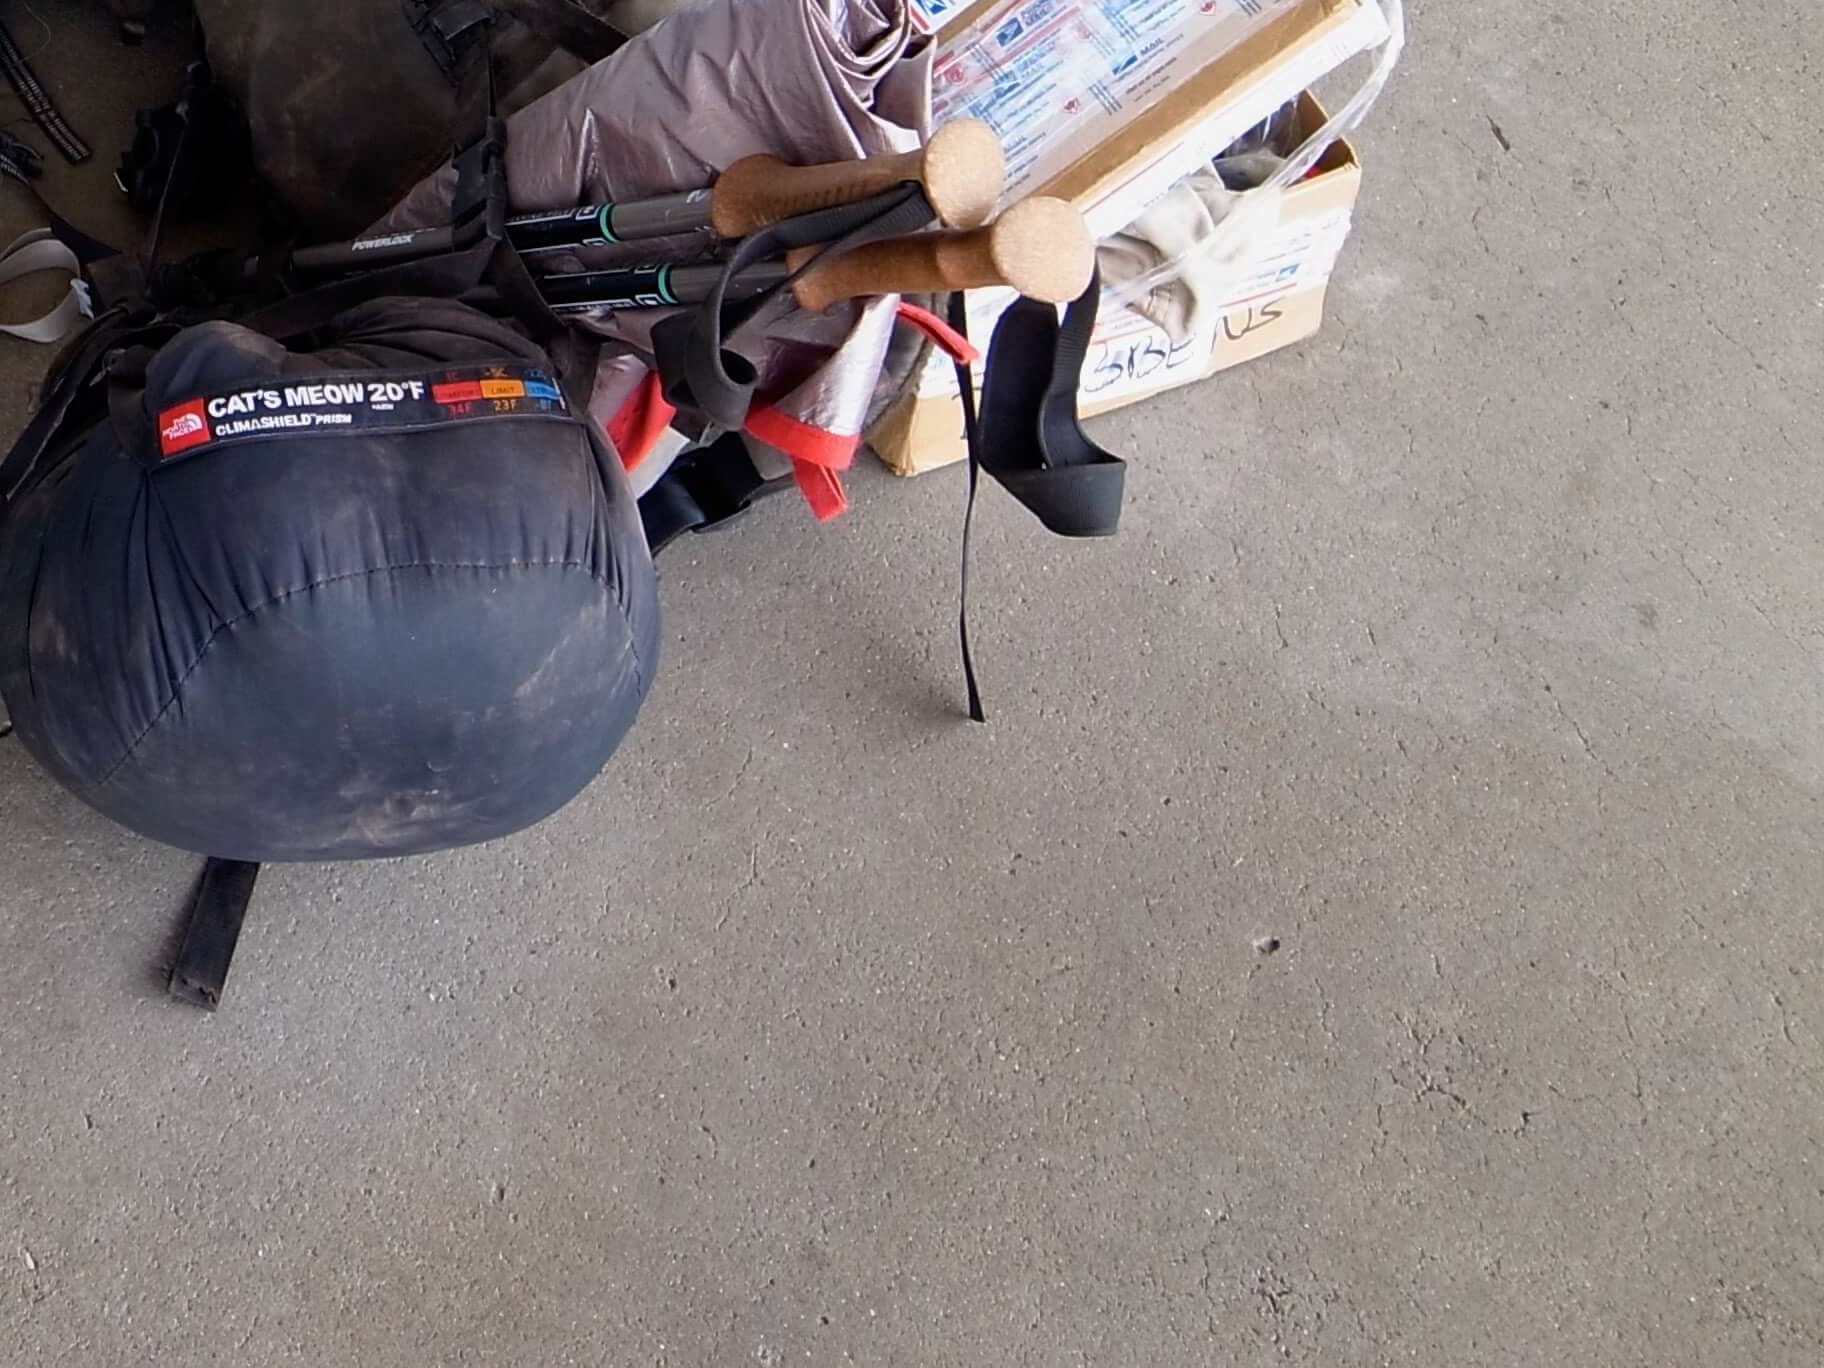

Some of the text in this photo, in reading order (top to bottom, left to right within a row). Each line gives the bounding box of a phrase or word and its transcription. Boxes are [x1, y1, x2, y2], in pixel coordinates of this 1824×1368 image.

[208, 381, 425, 418] CAT'S MEOW 20°F
[492, 400, 517, 411] 23F
